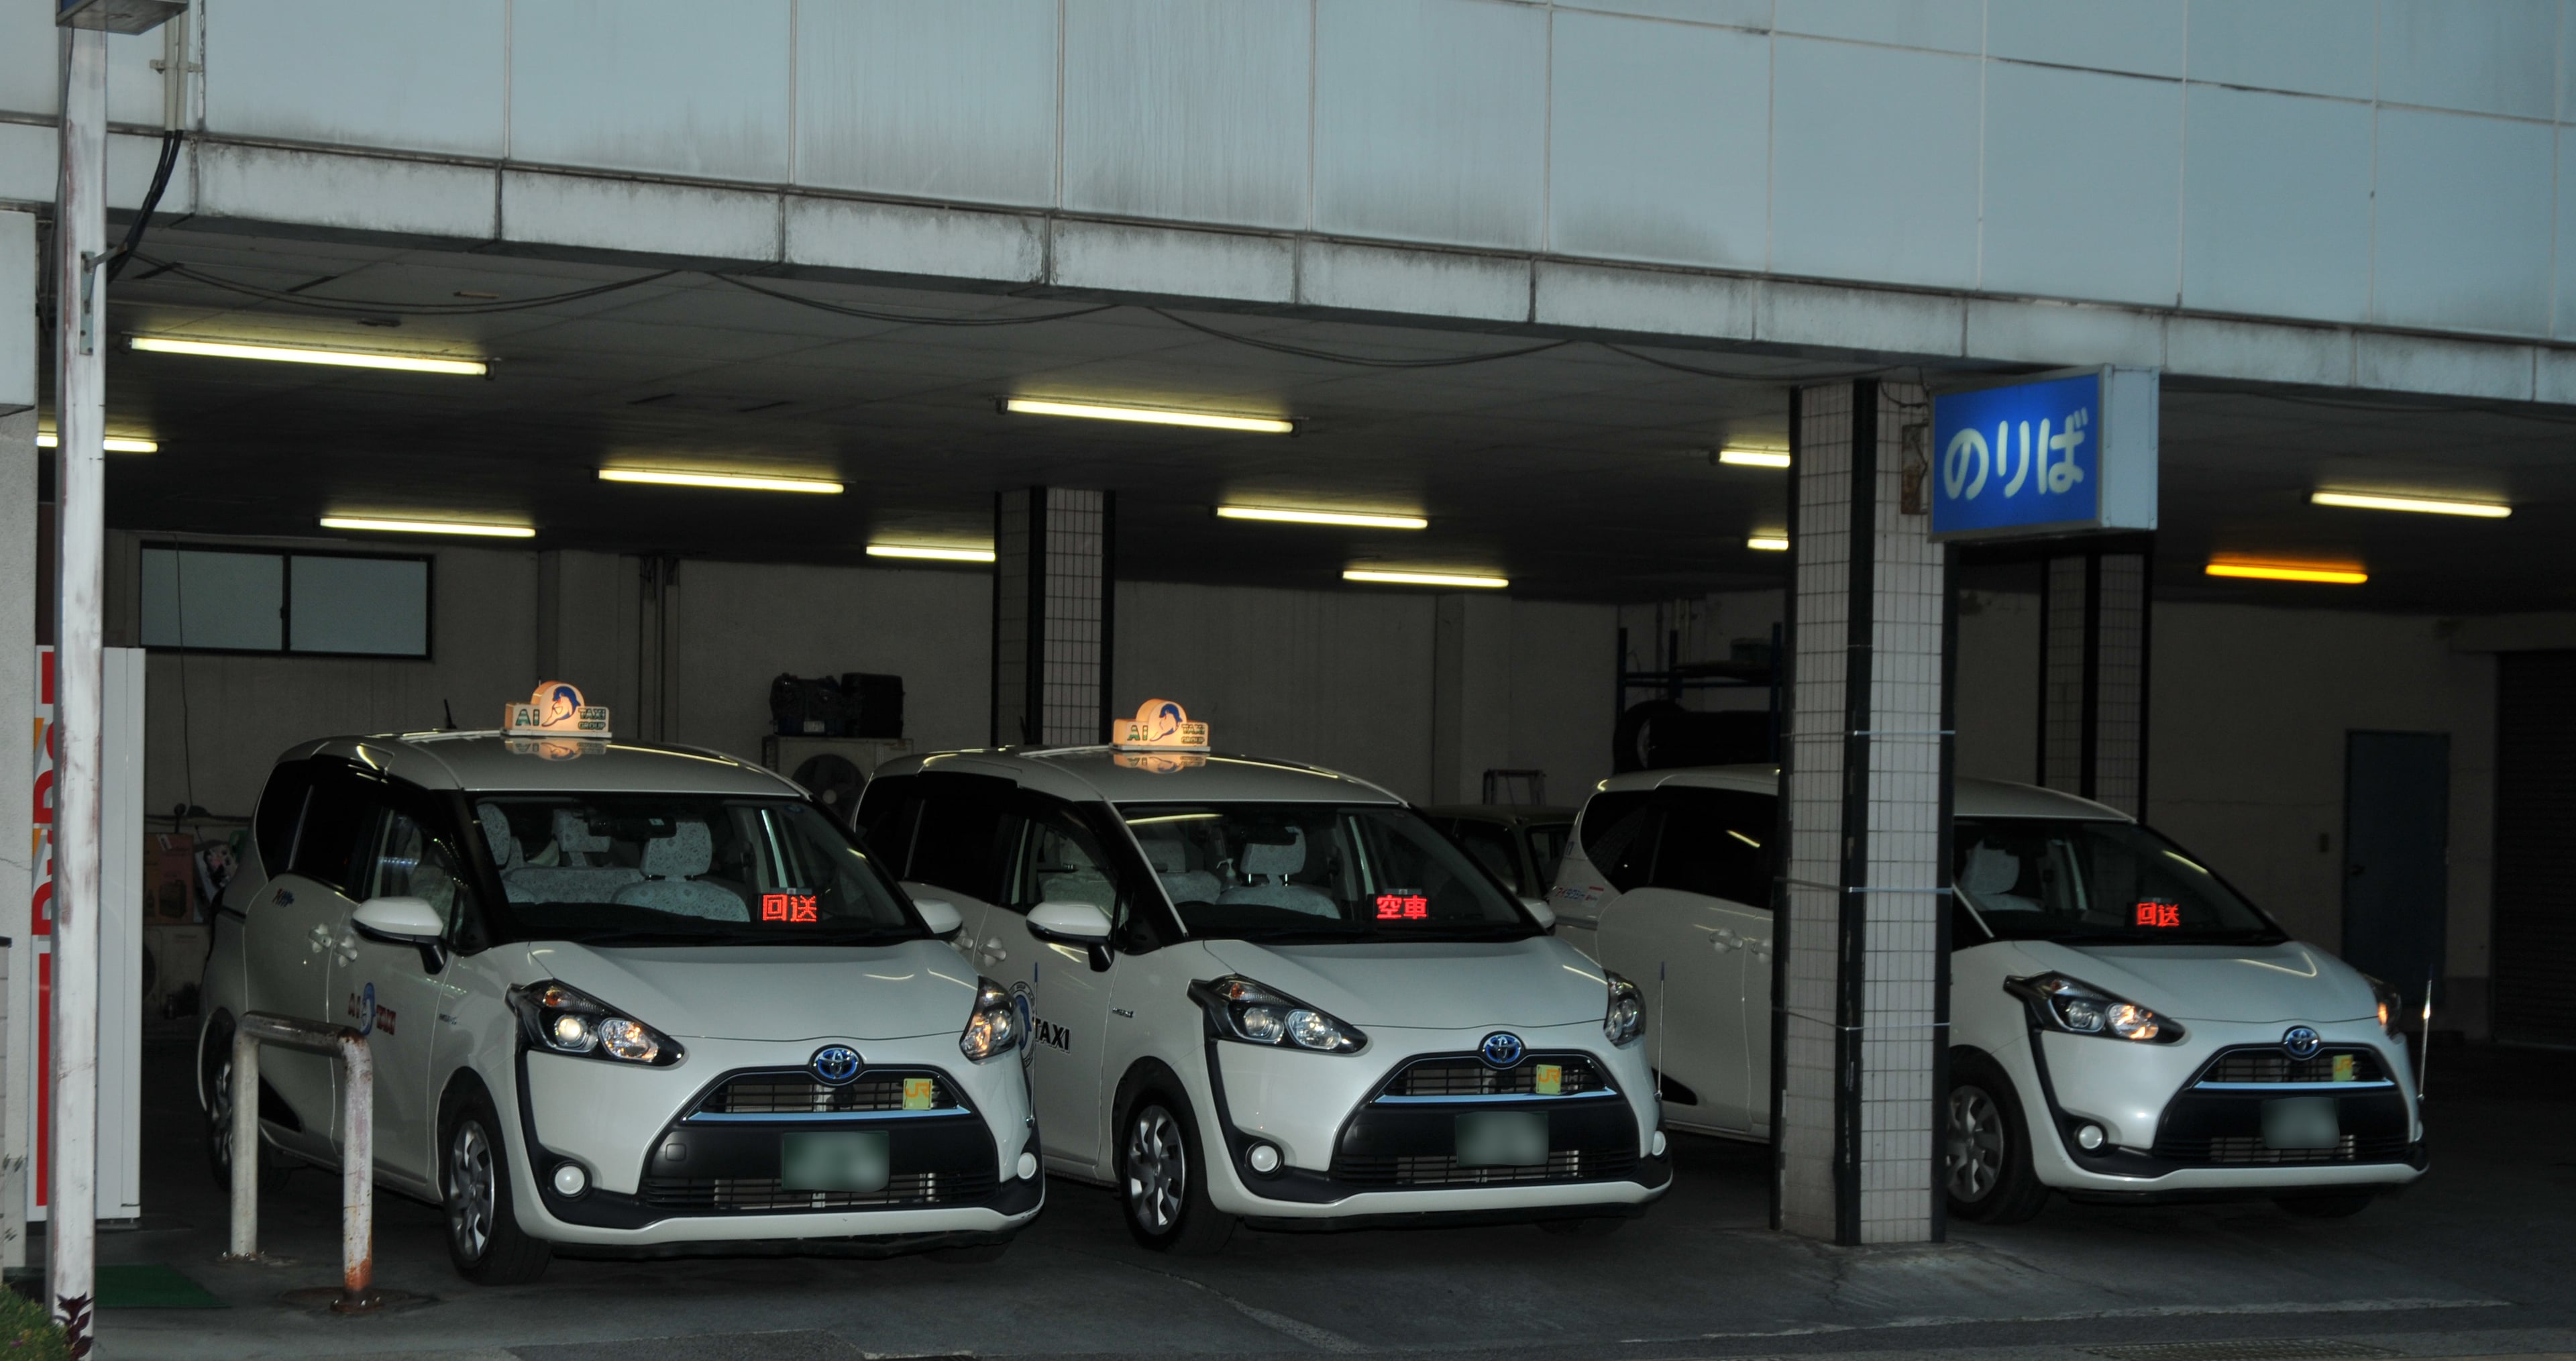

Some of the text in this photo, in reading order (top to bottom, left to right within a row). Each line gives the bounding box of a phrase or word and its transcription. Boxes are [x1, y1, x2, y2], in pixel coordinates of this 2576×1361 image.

[1943, 406, 2088, 500] のりば
[515, 708, 540, 726] AI
[578, 708, 606, 720] TAXI
[578, 721, 606, 730] GROUP
[1127, 724, 1148, 741] AI
[1181, 723, 1205, 735] TAXI
[762, 893, 817, 922] 回送
[1376, 893, 1428, 920] 空車
[2137, 902, 2180, 927] 回送
[1032, 1016, 1071, 1050] TAXI
[1538, 1068, 1560, 1084] JR
[905, 1082, 930, 1098] JR
